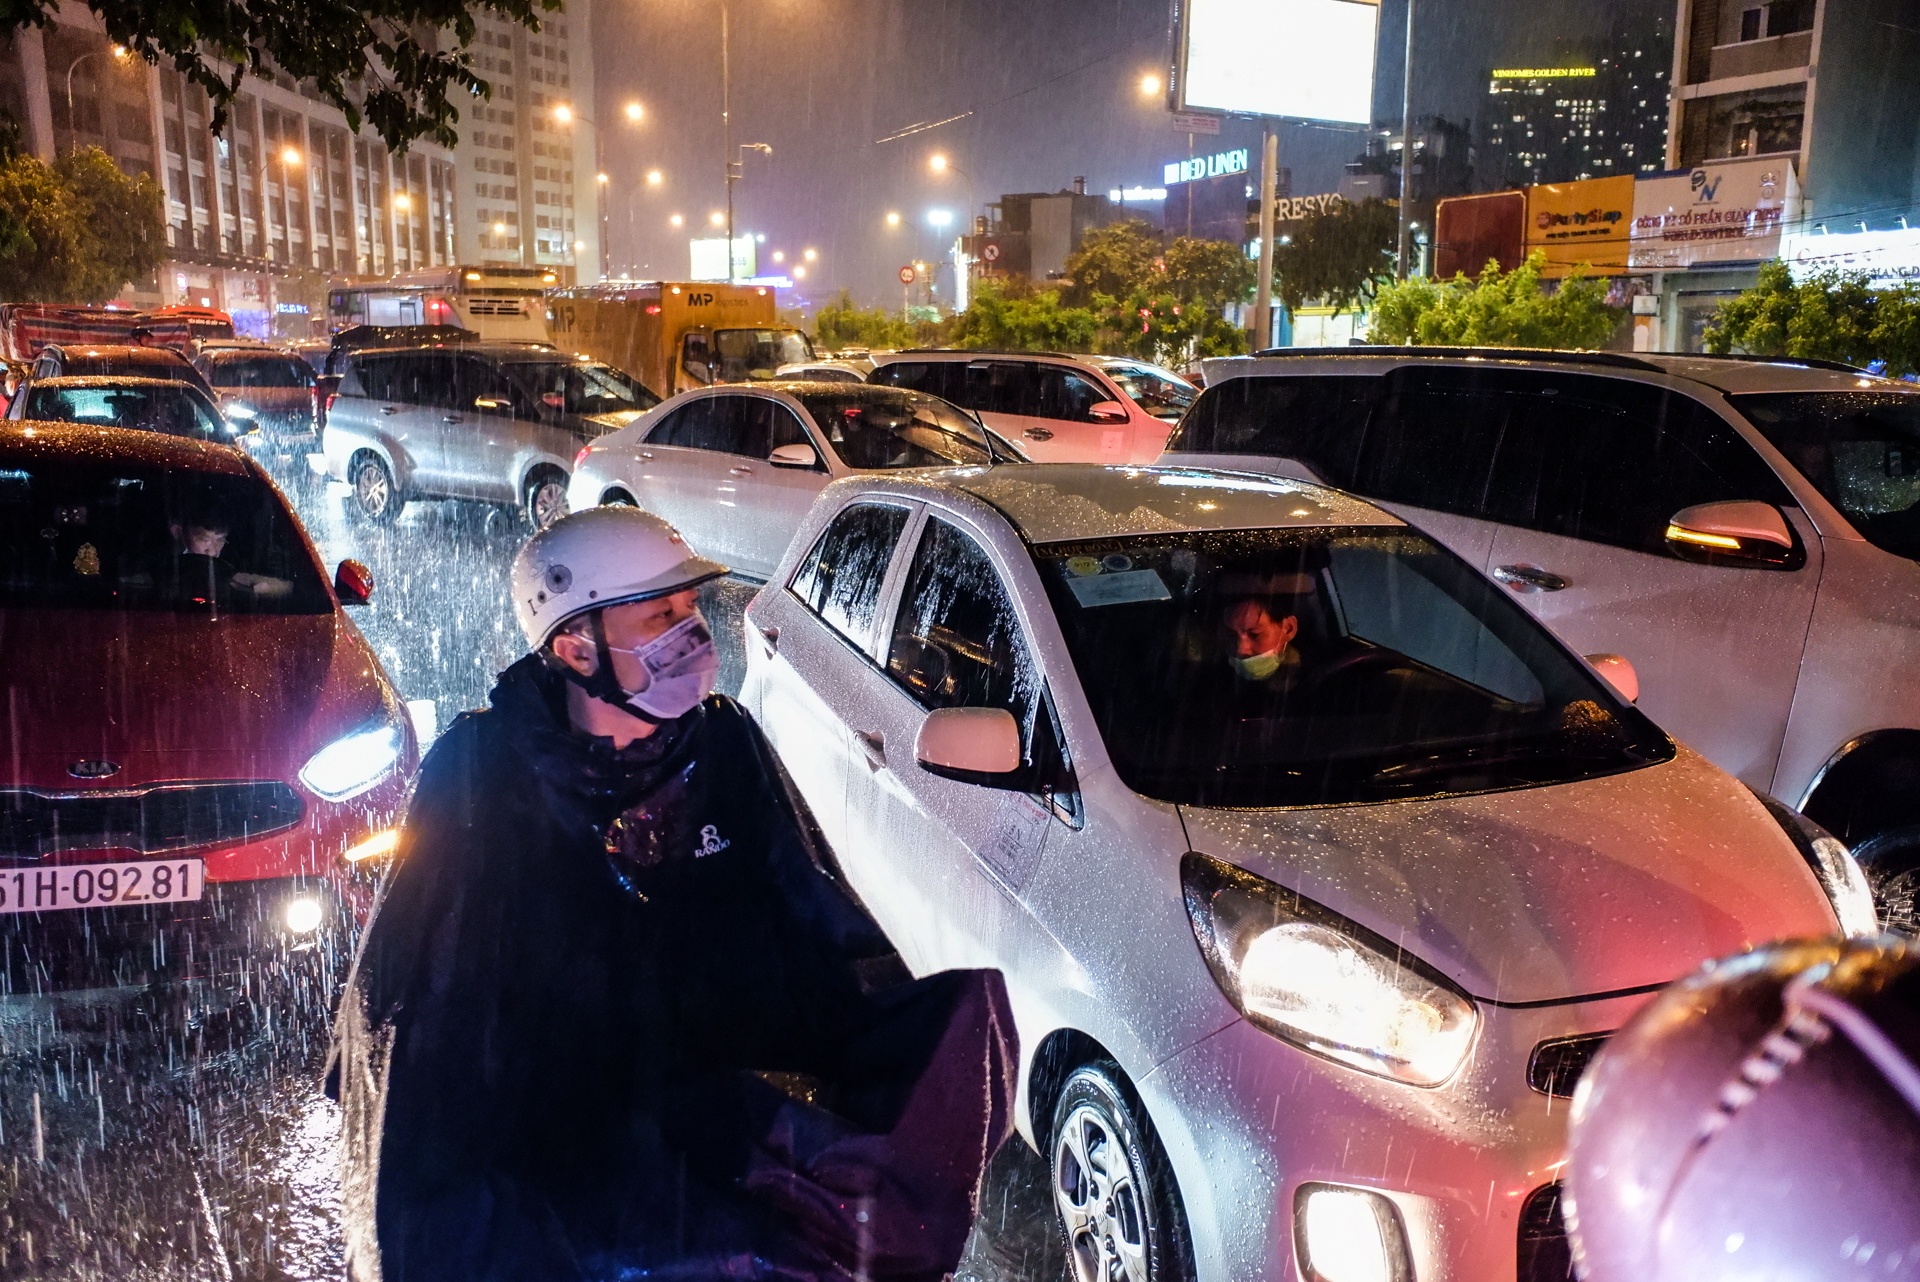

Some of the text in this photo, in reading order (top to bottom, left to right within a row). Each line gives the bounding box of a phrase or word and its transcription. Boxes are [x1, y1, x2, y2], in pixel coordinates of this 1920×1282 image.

[1492, 68, 1596, 78] VINHOMES GOLDEN RIVER
[1180, 148, 1248, 182] BED LINEN
[688, 293, 714, 306] MP
[75, 762, 113, 774] KIA
